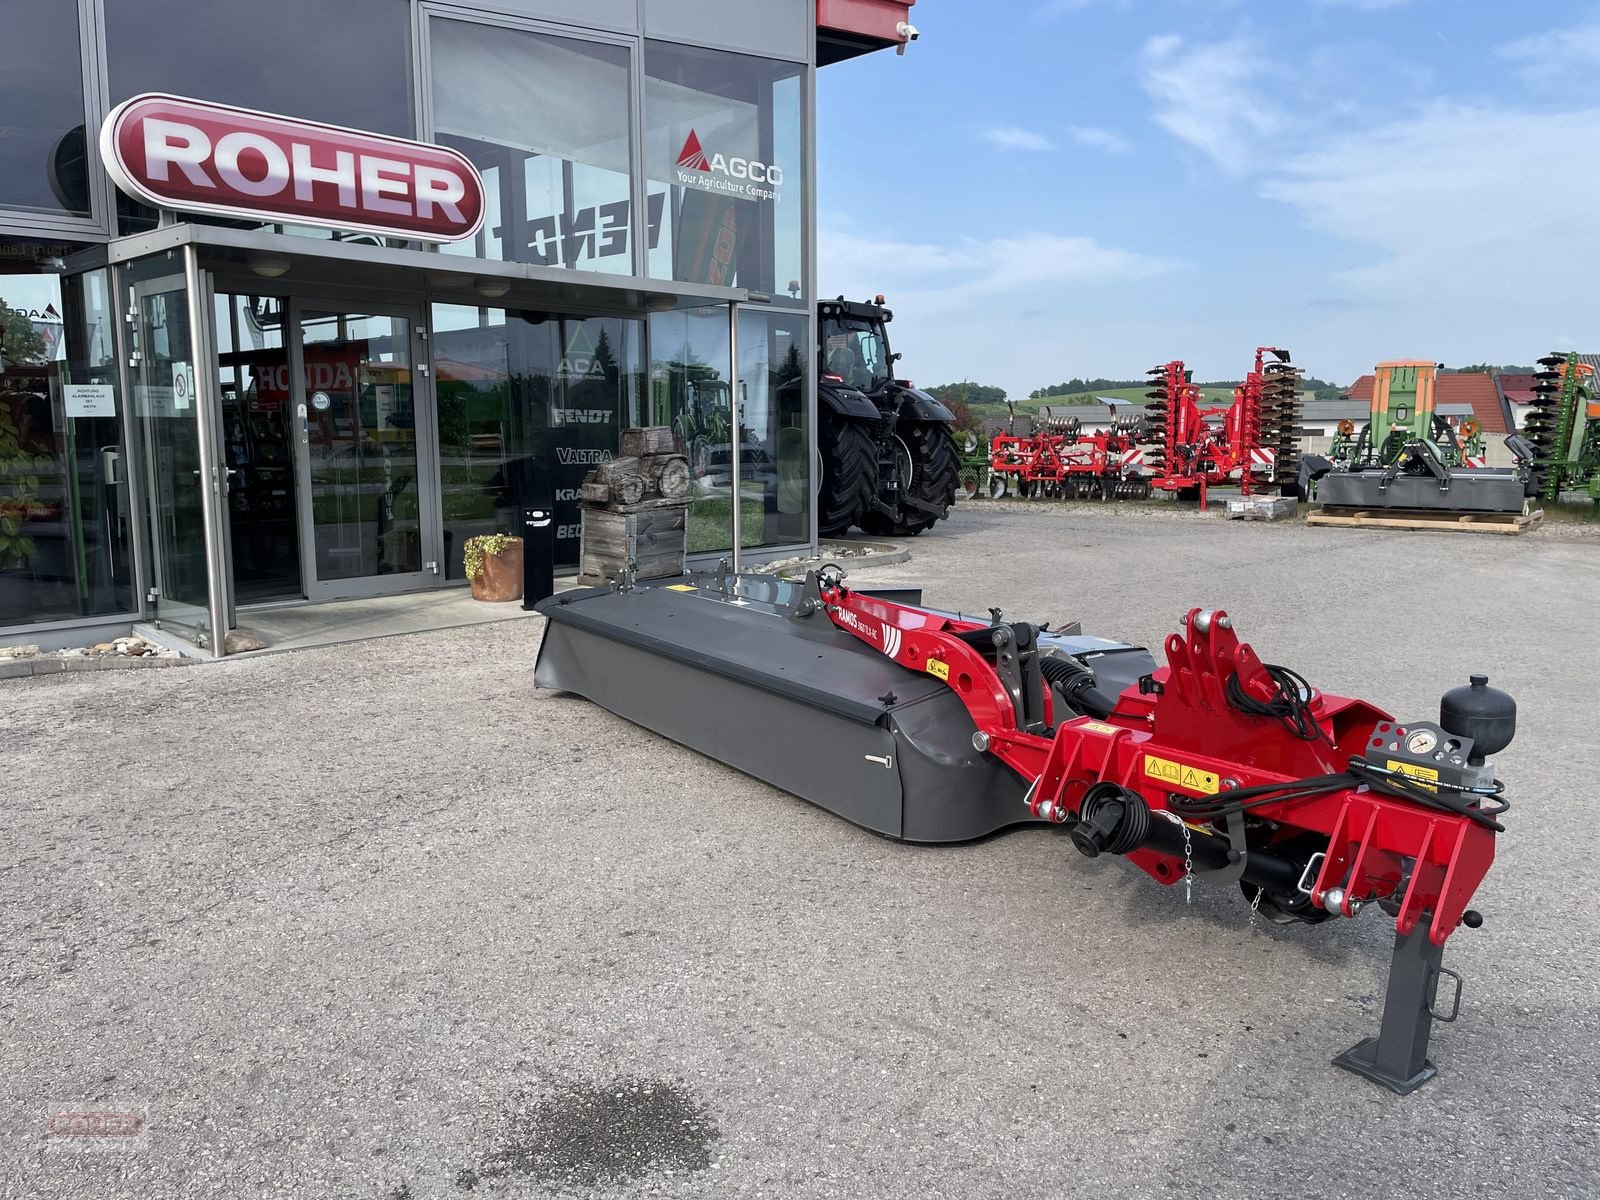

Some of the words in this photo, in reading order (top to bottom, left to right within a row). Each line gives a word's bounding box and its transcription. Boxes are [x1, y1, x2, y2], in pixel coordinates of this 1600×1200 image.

[142, 117, 468, 225] ROHER
[711, 153, 783, 186] AGCO
[677, 170, 696, 184] Your
[699, 176, 744, 193] Agriculture
[746, 184, 781, 203] Company
[557, 358, 604, 374] ACA
[556, 409, 612, 423] FENDT
[838, 605, 857, 628] RAMOS
